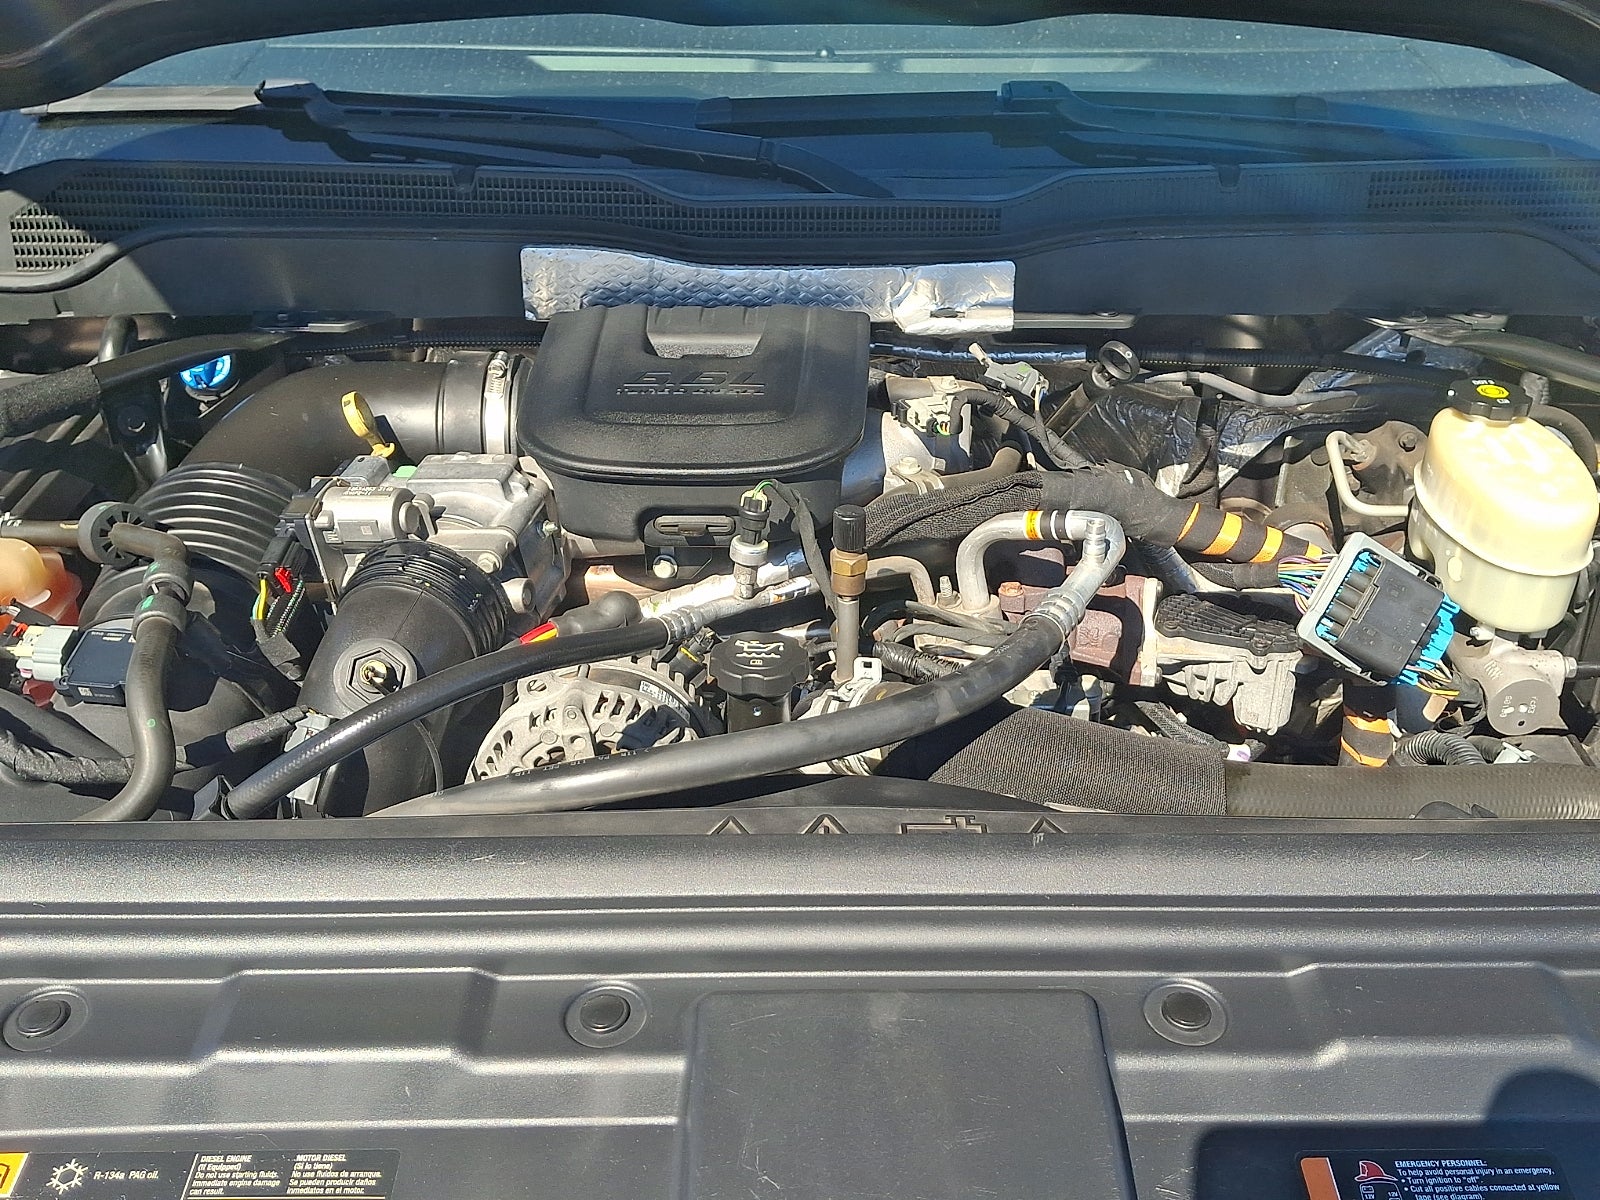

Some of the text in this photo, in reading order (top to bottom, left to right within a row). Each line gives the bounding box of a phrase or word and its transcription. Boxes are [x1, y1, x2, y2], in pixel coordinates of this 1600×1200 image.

[207, 1163, 242, 1172] Equipped)
[93, 1170, 125, 1179] R-134a
[128, 1170, 146, 1179] PAG
[231, 1171, 257, 1179] starting
[1408, 1168, 1423, 1177] help
[1445, 1168, 1474, 1176] personal
[1475, 1168, 1494, 1176] injury
[229, 1180, 252, 1188] engine
[253, 1179, 280, 1188] damage
[1435, 1185, 1463, 1193] positive
[1536, 1183, 1560, 1192] yellow
